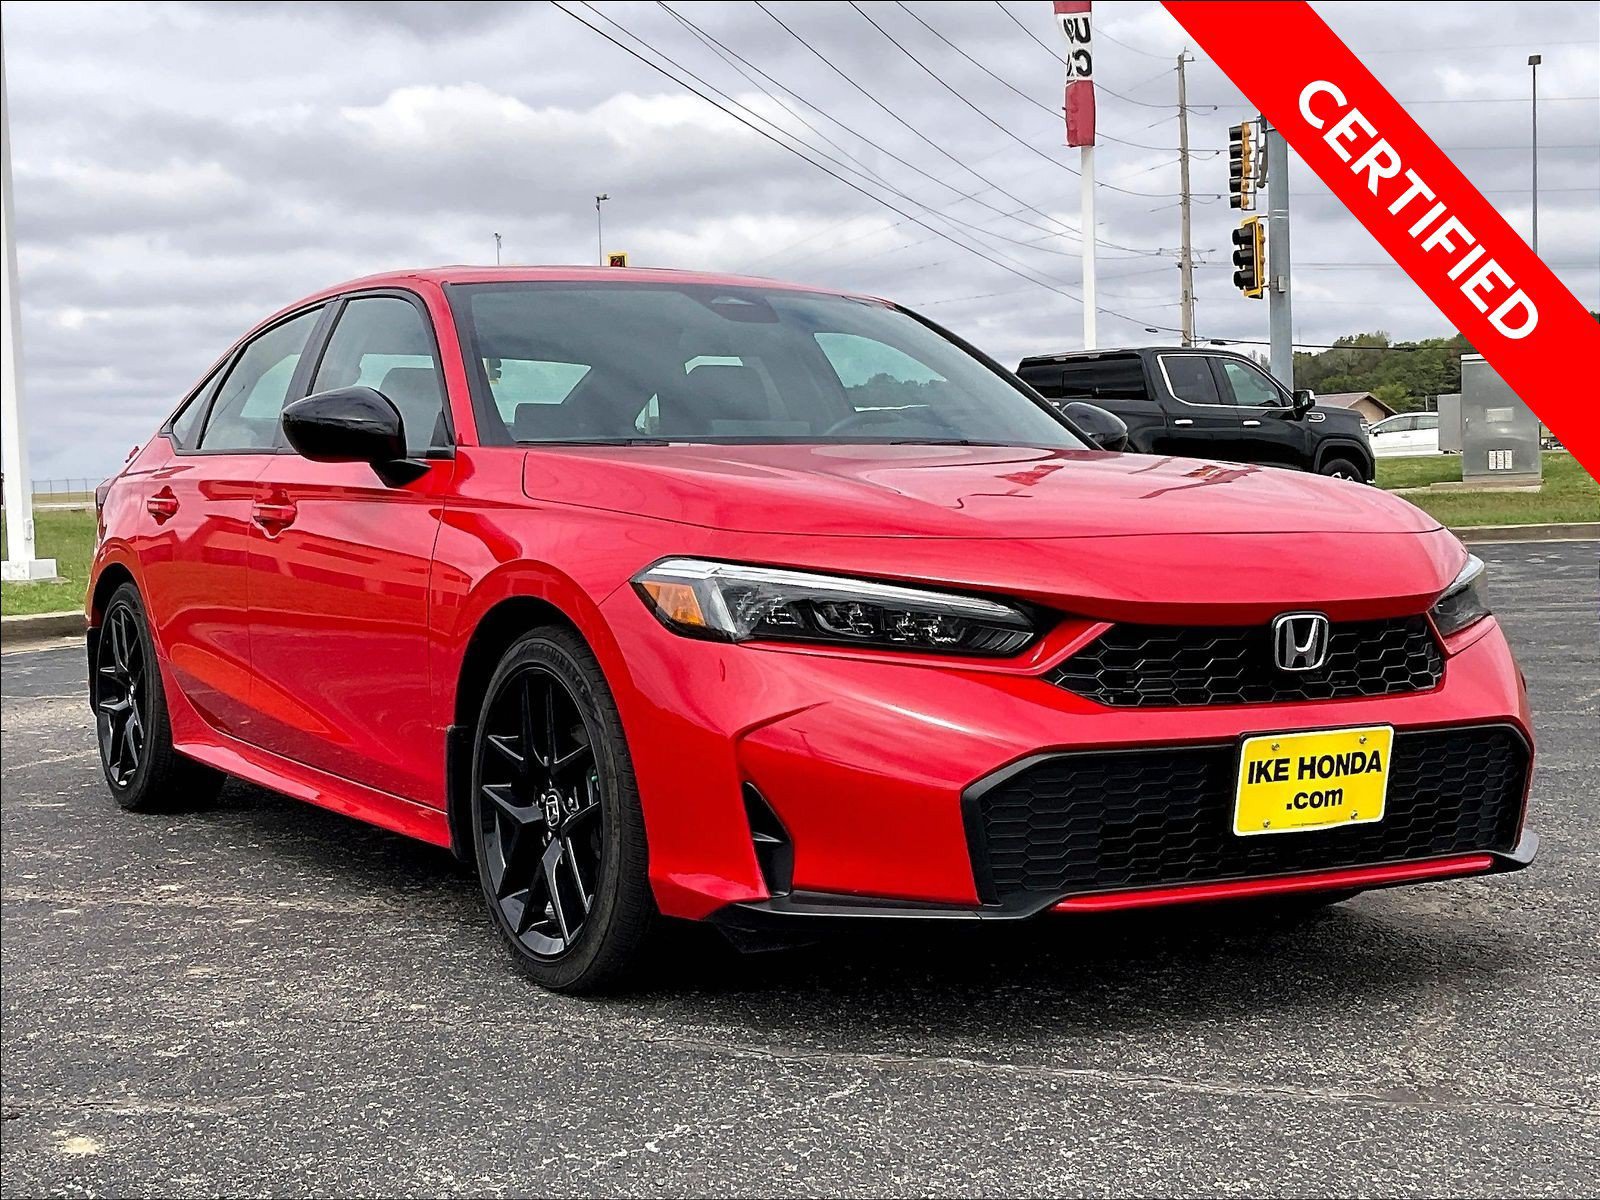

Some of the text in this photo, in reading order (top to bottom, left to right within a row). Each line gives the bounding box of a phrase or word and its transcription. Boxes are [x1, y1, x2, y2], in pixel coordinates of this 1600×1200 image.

[1247, 750, 1382, 785] IKE HONDA
[1286, 787, 1343, 810] .com
